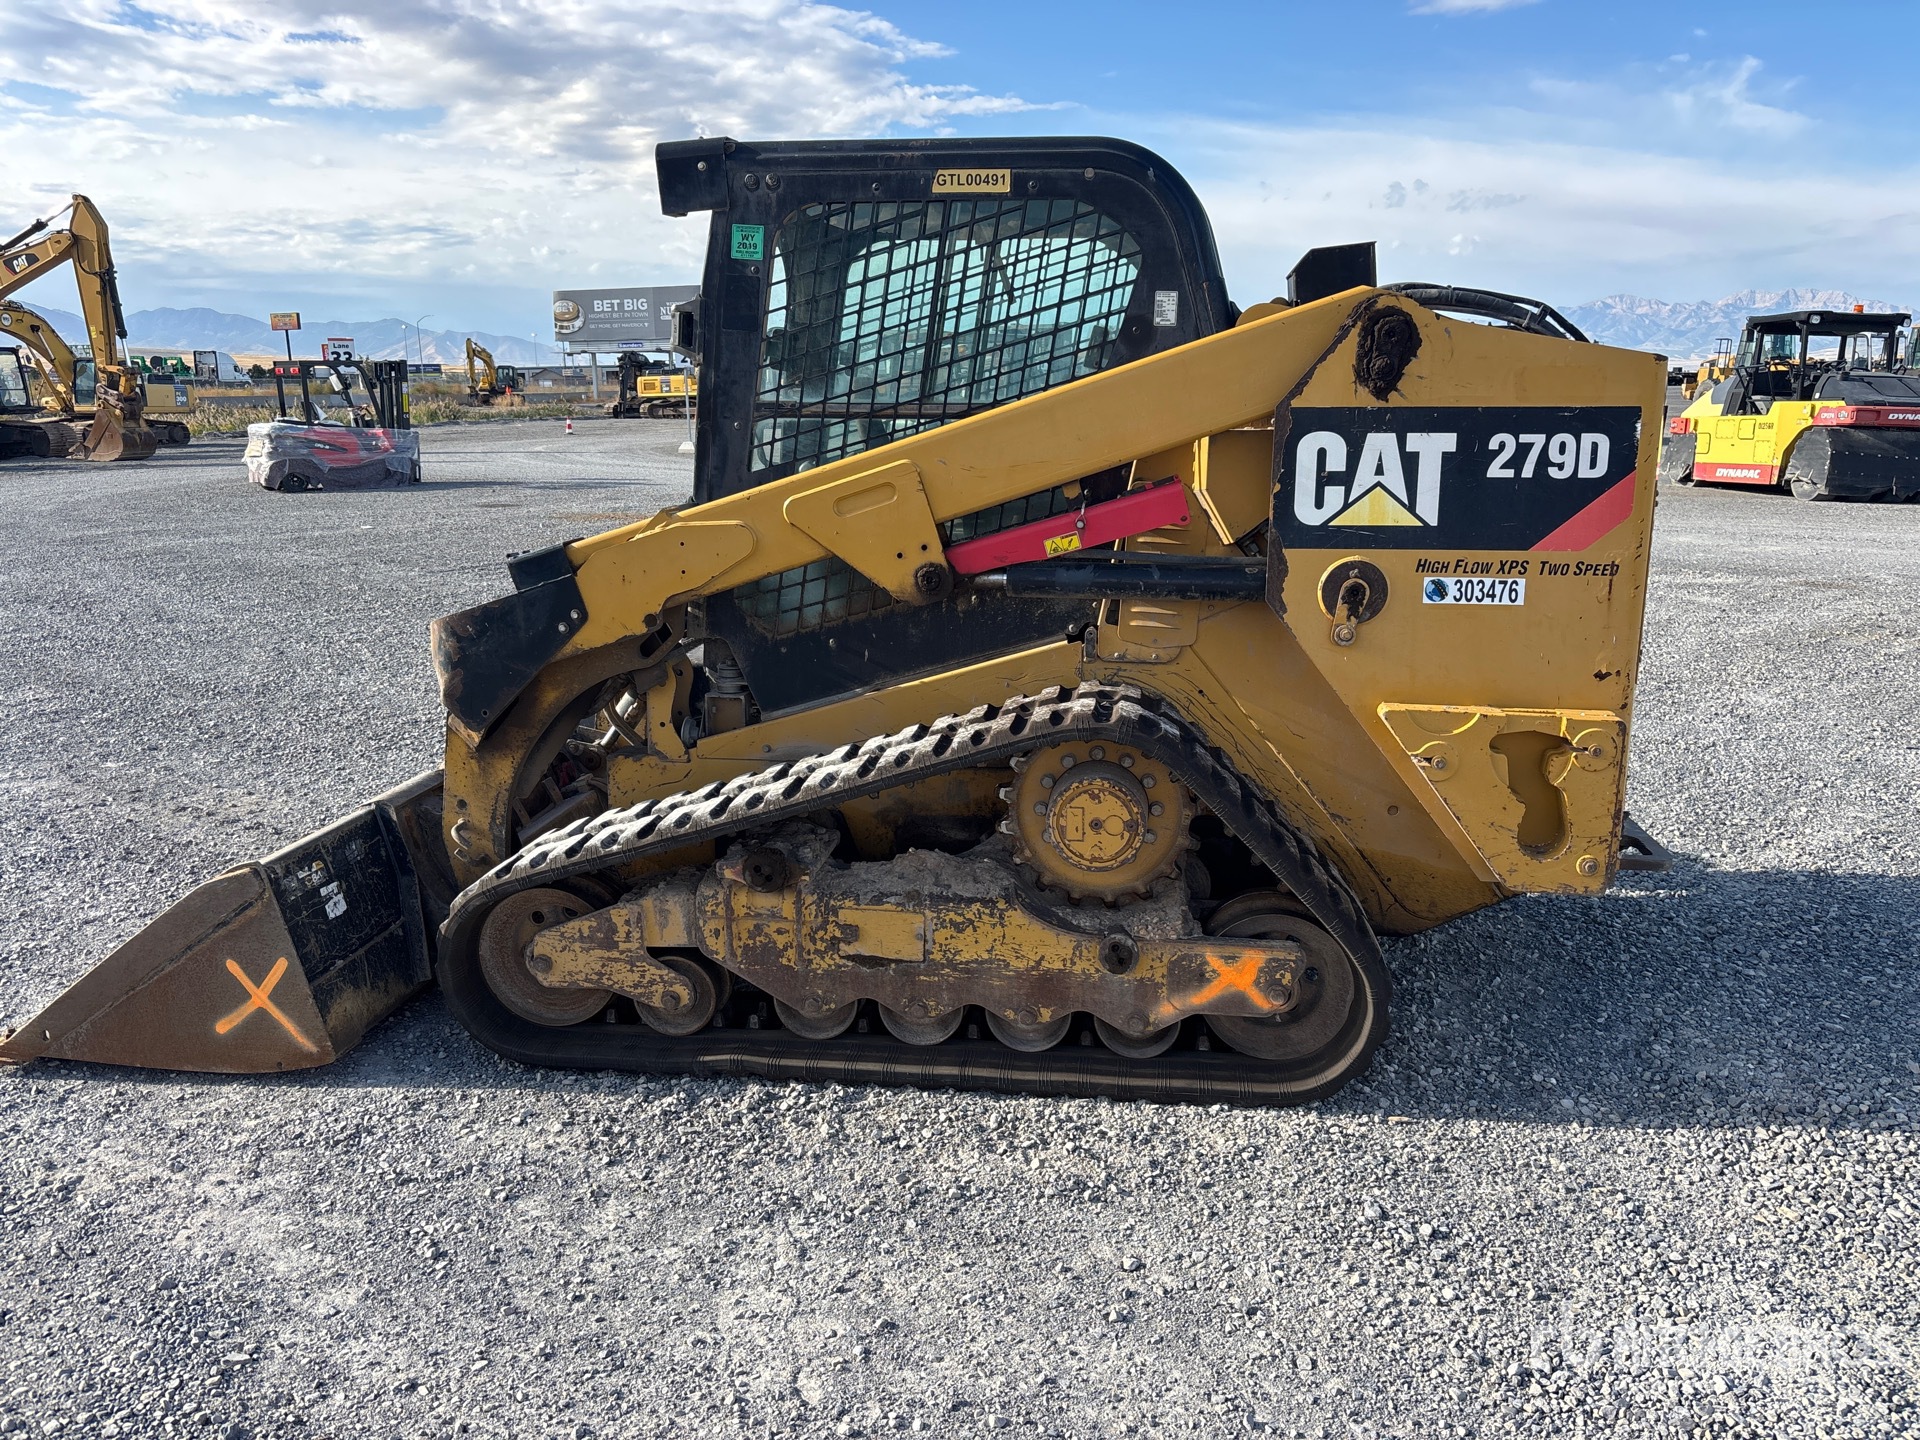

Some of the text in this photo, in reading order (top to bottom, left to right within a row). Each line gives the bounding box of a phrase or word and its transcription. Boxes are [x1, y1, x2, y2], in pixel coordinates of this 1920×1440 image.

[936, 173, 1006, 186] GTL00491
[741, 233, 756, 241] WY
[736, 241, 758, 250] 2019
[12, 254, 29, 273] CAT
[593, 299, 621, 312] BET
[624, 298, 648, 311] BIG
[1293, 431, 1610, 526] CAT 279D
[1715, 468, 1761, 479] DYNAPAC
[1496, 560, 1530, 576] XPS
[1452, 578, 1519, 604] 303476
